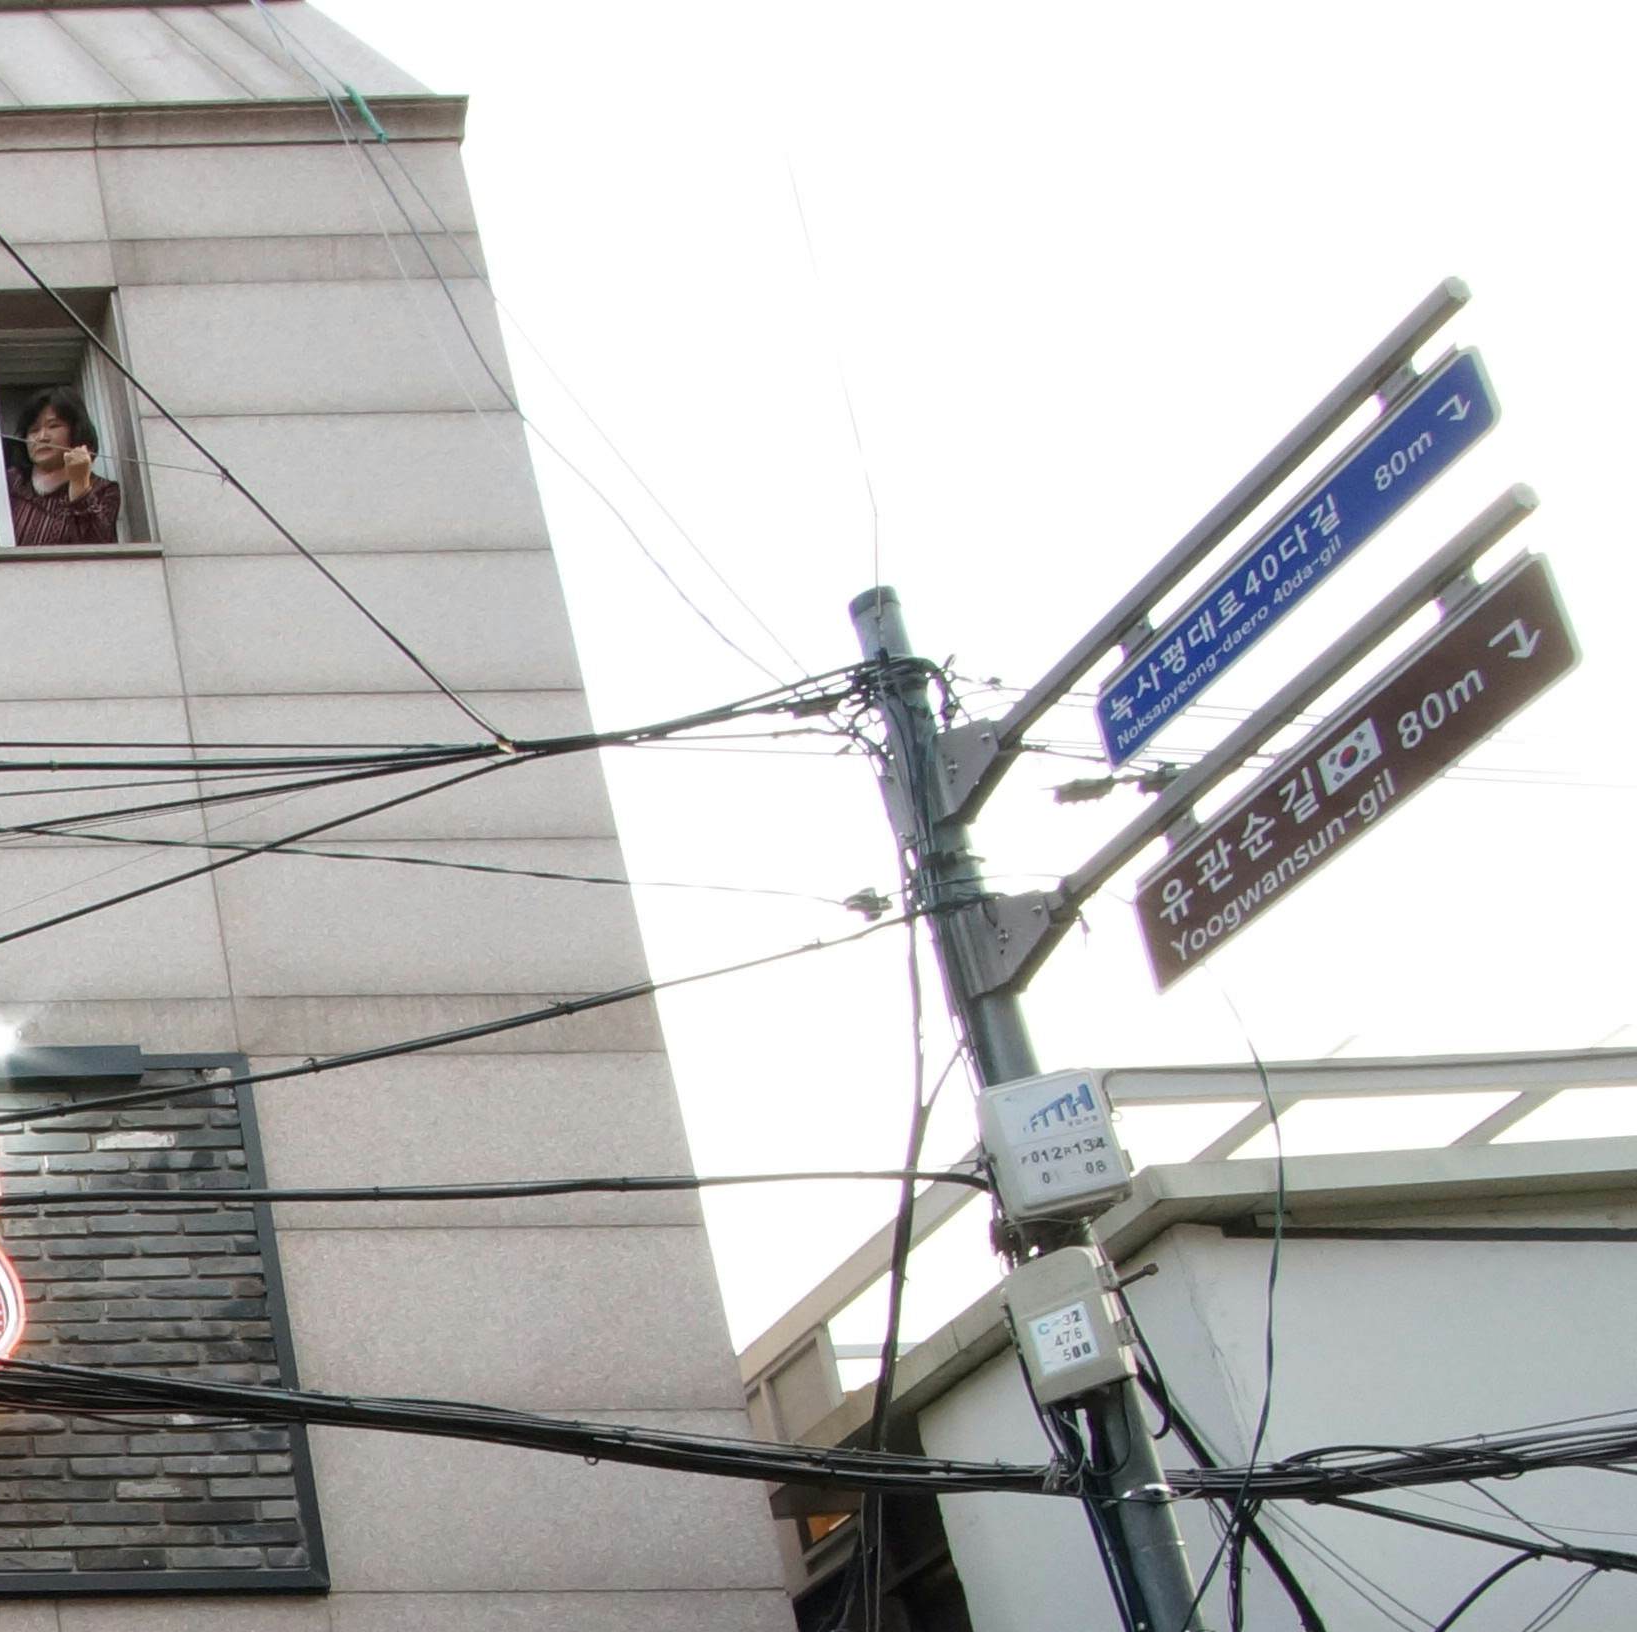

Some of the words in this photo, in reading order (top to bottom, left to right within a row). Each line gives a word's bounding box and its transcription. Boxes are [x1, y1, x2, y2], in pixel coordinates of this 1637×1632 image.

[1373, 431, 1434, 492] 80m
[1117, 603, 1269, 751] Noksapyeong-daero
[1271, 534, 1343, 609] 40da-gil
[1397, 663, 1486, 751] 80m
[1161, 768, 1320, 926] 유관순길
[1170, 771, 1397, 965] Yoogwansun-gil
